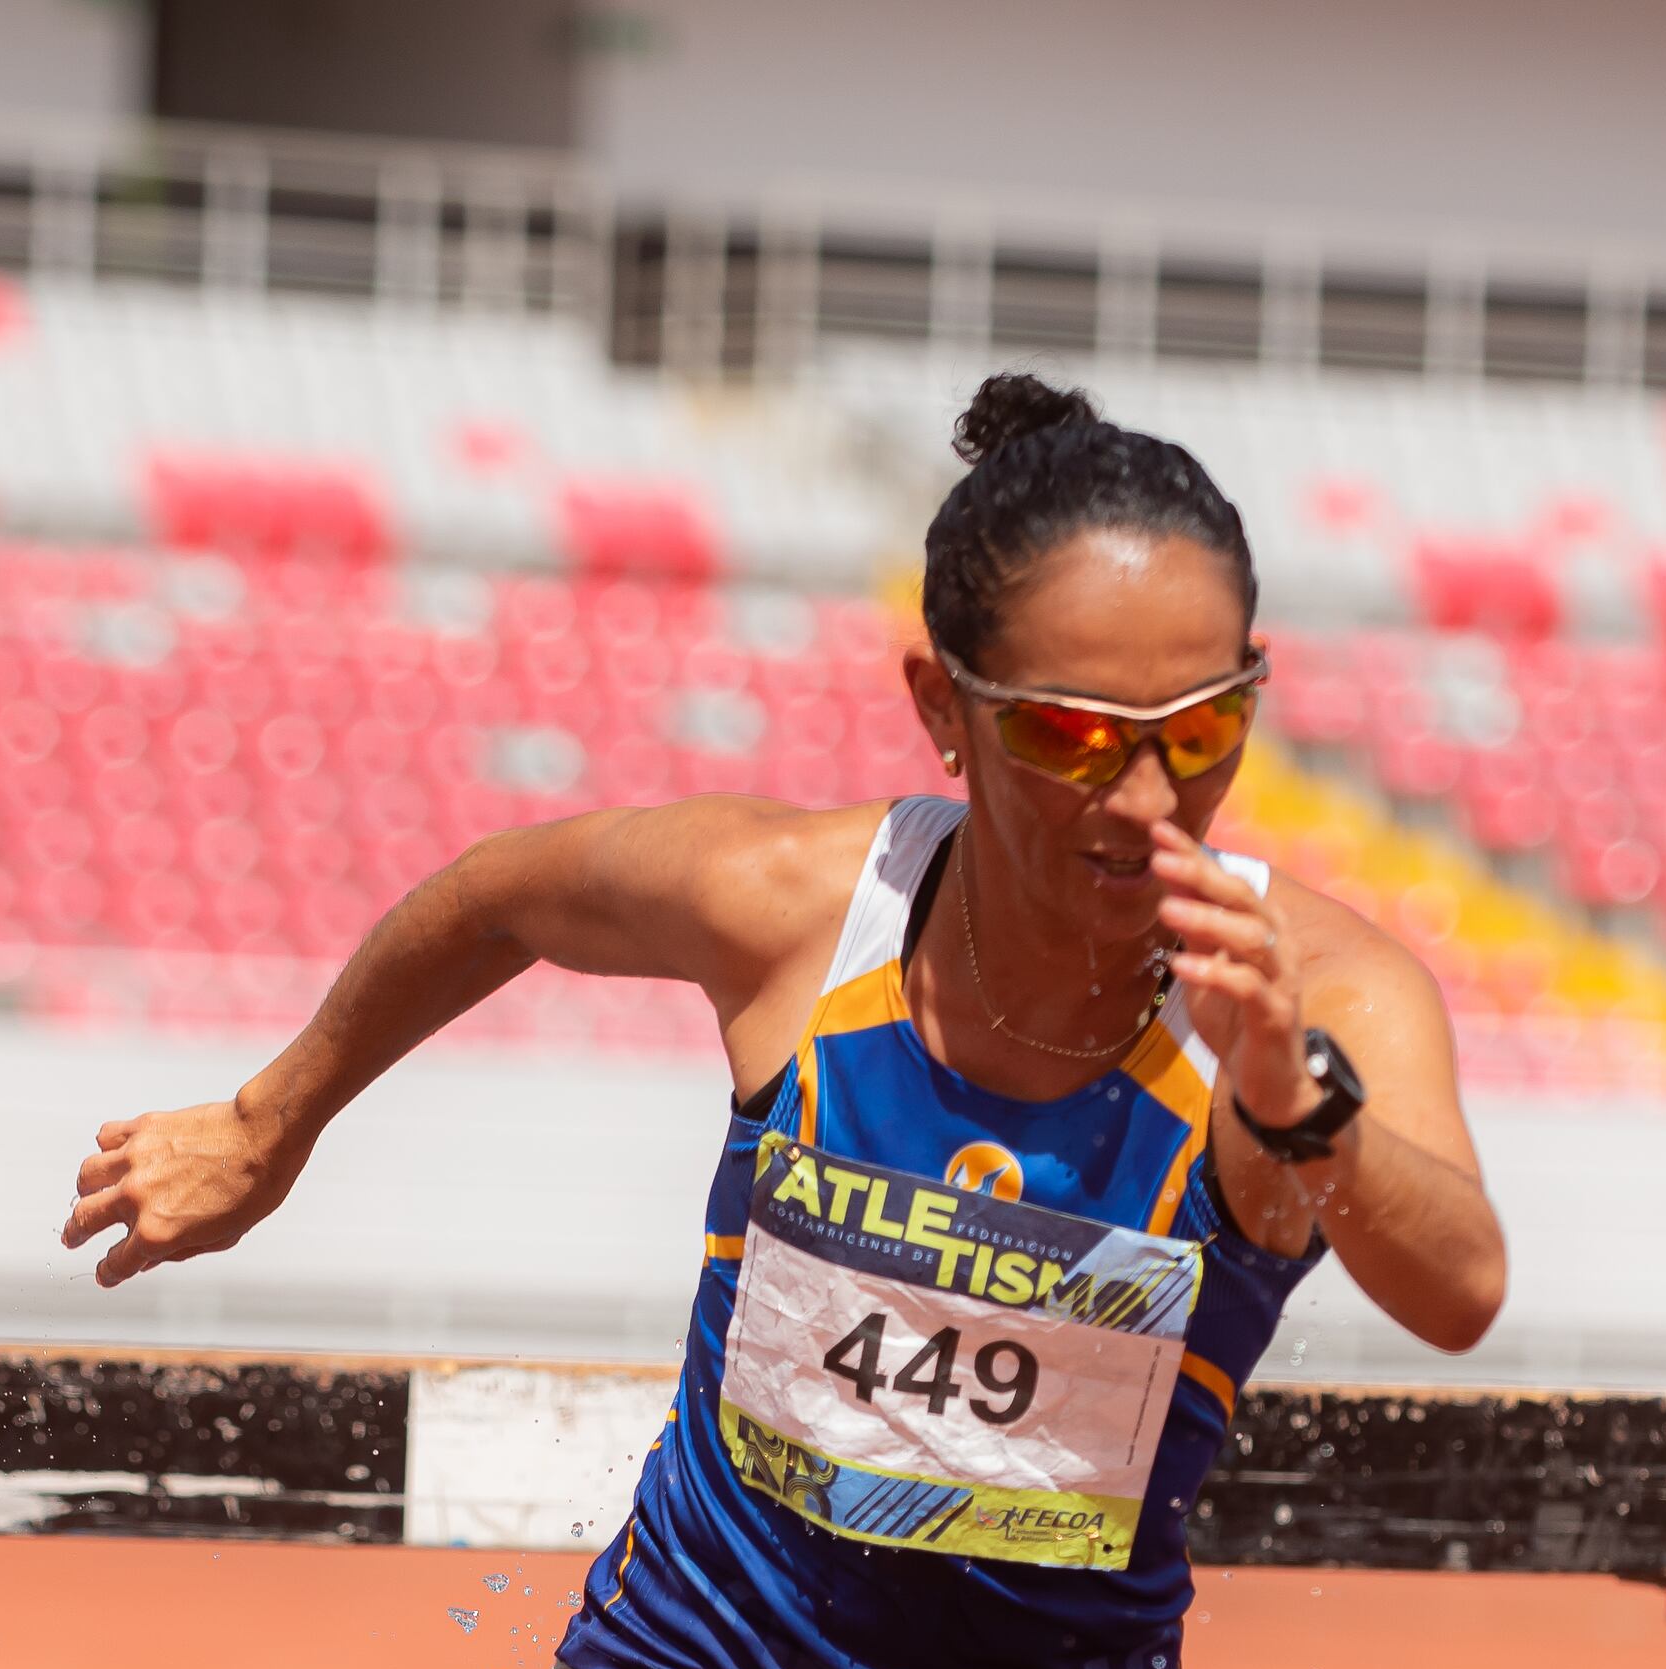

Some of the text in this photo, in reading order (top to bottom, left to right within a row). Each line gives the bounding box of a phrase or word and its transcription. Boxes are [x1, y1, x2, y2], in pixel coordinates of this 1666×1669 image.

[768, 1202, 936, 1265] COSTARRICENSE DE
[773, 1155, 958, 1249] ATLE
[956, 1222, 1072, 1262] FEDERACIÓN
[823, 1312, 1040, 1425] 449
[1018, 1508, 1105, 1530] FECOA
